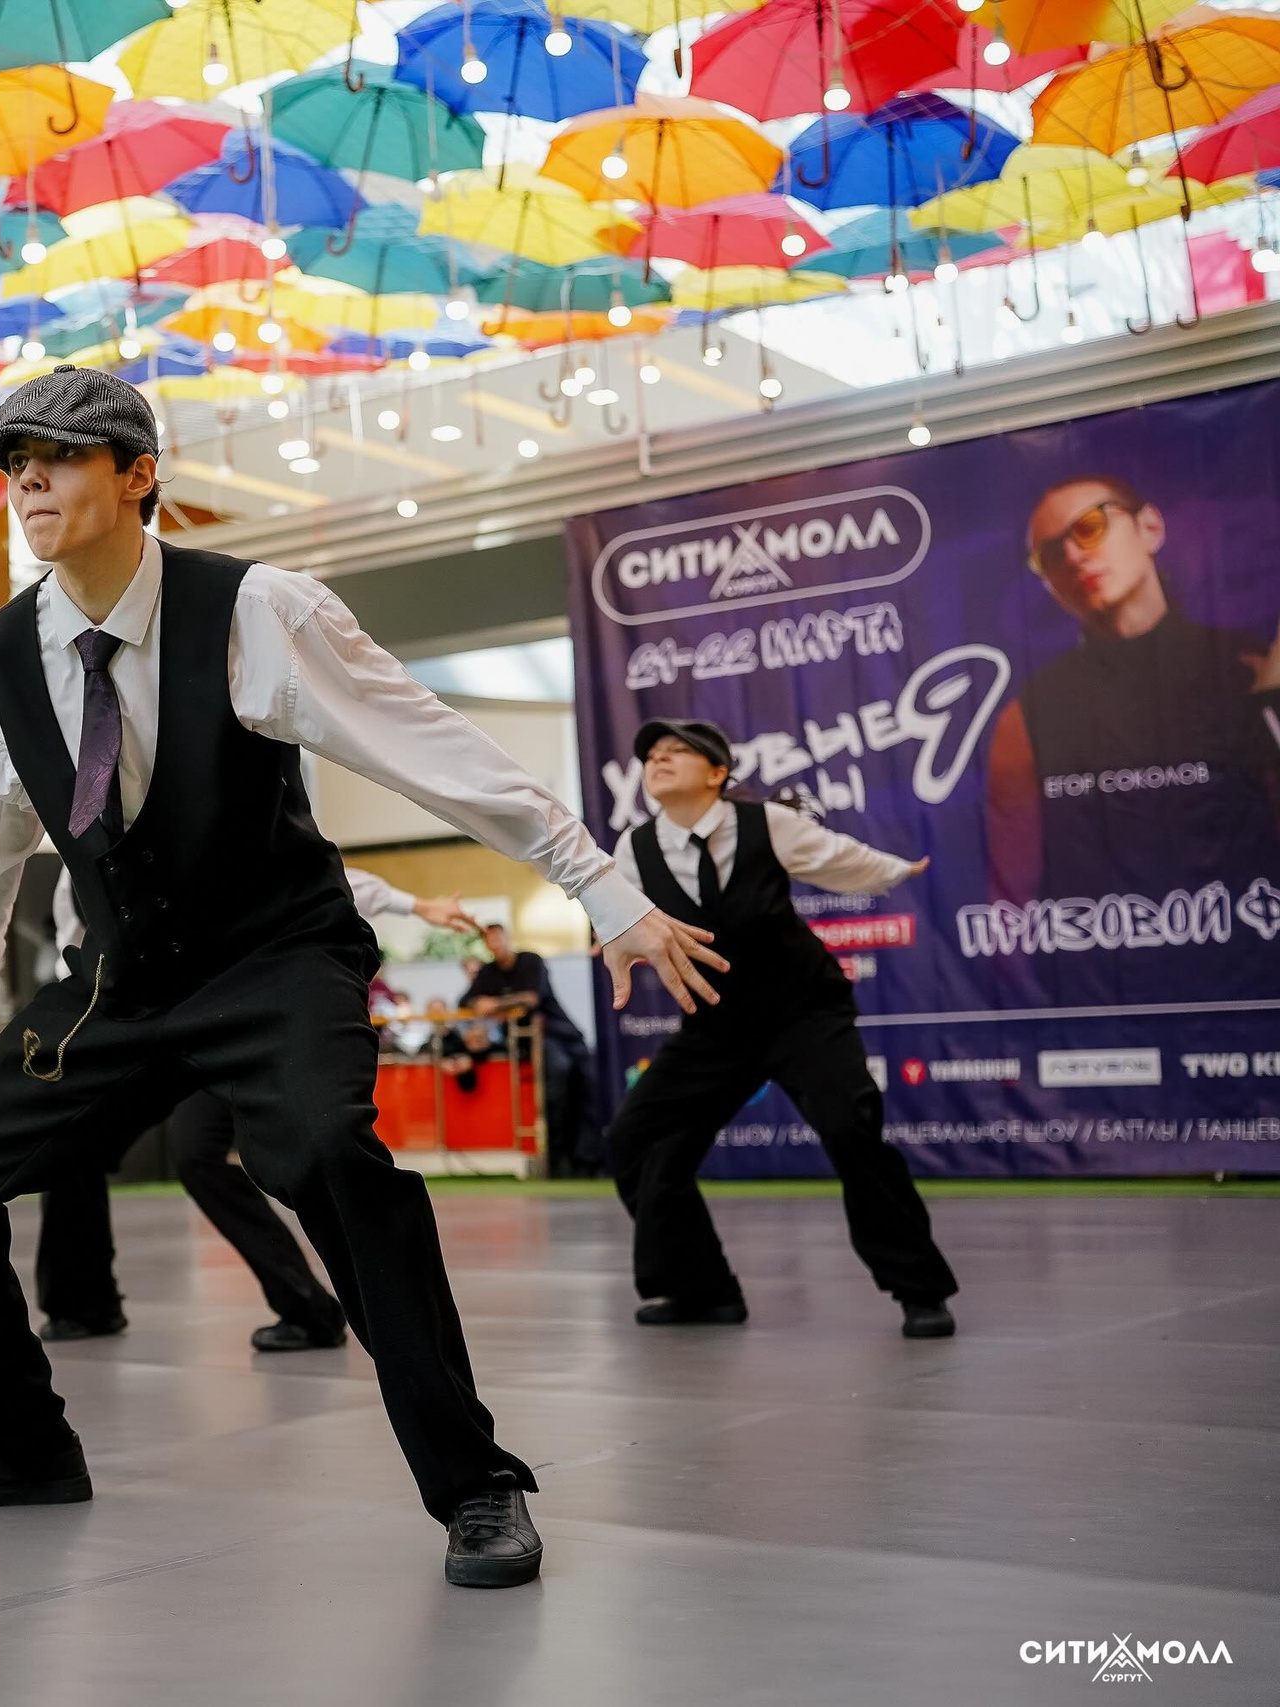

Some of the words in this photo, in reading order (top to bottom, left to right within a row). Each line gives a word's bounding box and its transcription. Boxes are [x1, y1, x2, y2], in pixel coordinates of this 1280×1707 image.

[618, 535, 734, 589] СИТИ
[763, 507, 901, 562] МОЛЛ
[760, 601, 904, 669] МАРТА
[1044, 772, 1095, 799] ЕГОР
[1097, 761, 1210, 793] СОКОЛОВ
[956, 880, 1231, 958] ПРИЗОВОЙ
[1180, 1051, 1248, 1078] TWO
